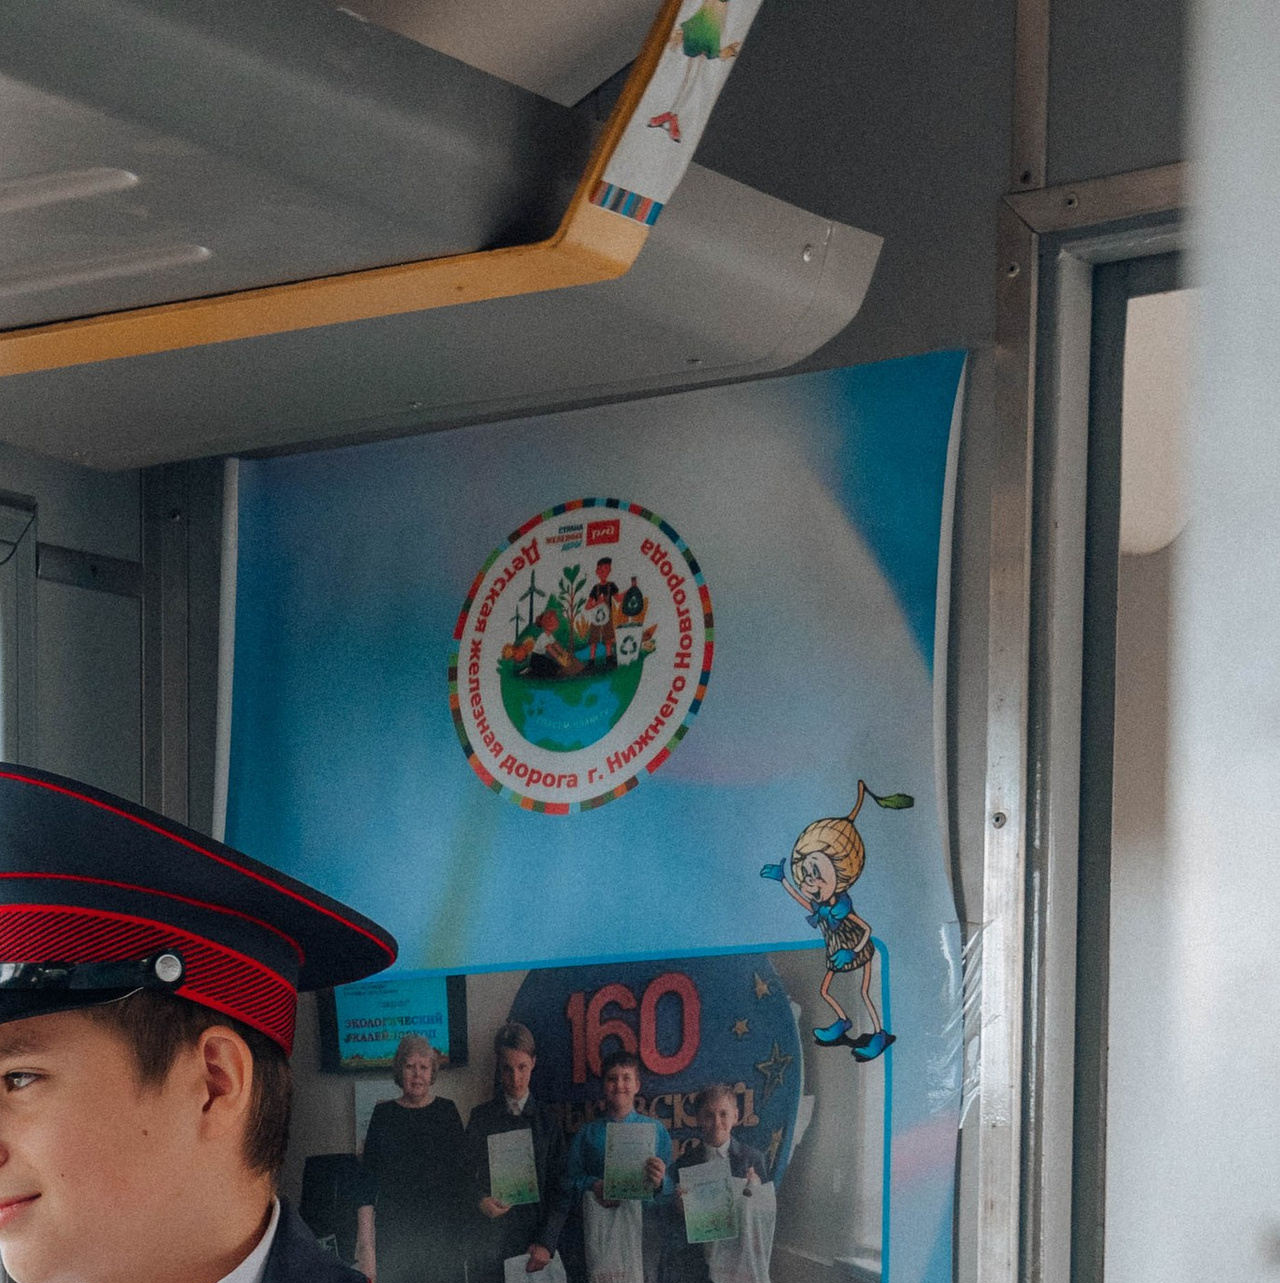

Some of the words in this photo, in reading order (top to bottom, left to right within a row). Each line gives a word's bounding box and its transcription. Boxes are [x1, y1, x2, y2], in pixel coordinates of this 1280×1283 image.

[474, 538, 540, 633] Детская
[640, 538, 693, 669] Новгорода
[468, 638, 504, 758] железная
[606, 676, 686, 774] Нижнего
[499, 754, 578, 788] дорога
[587, 768, 605, 784] г.
[566, 971, 701, 1084] 160
